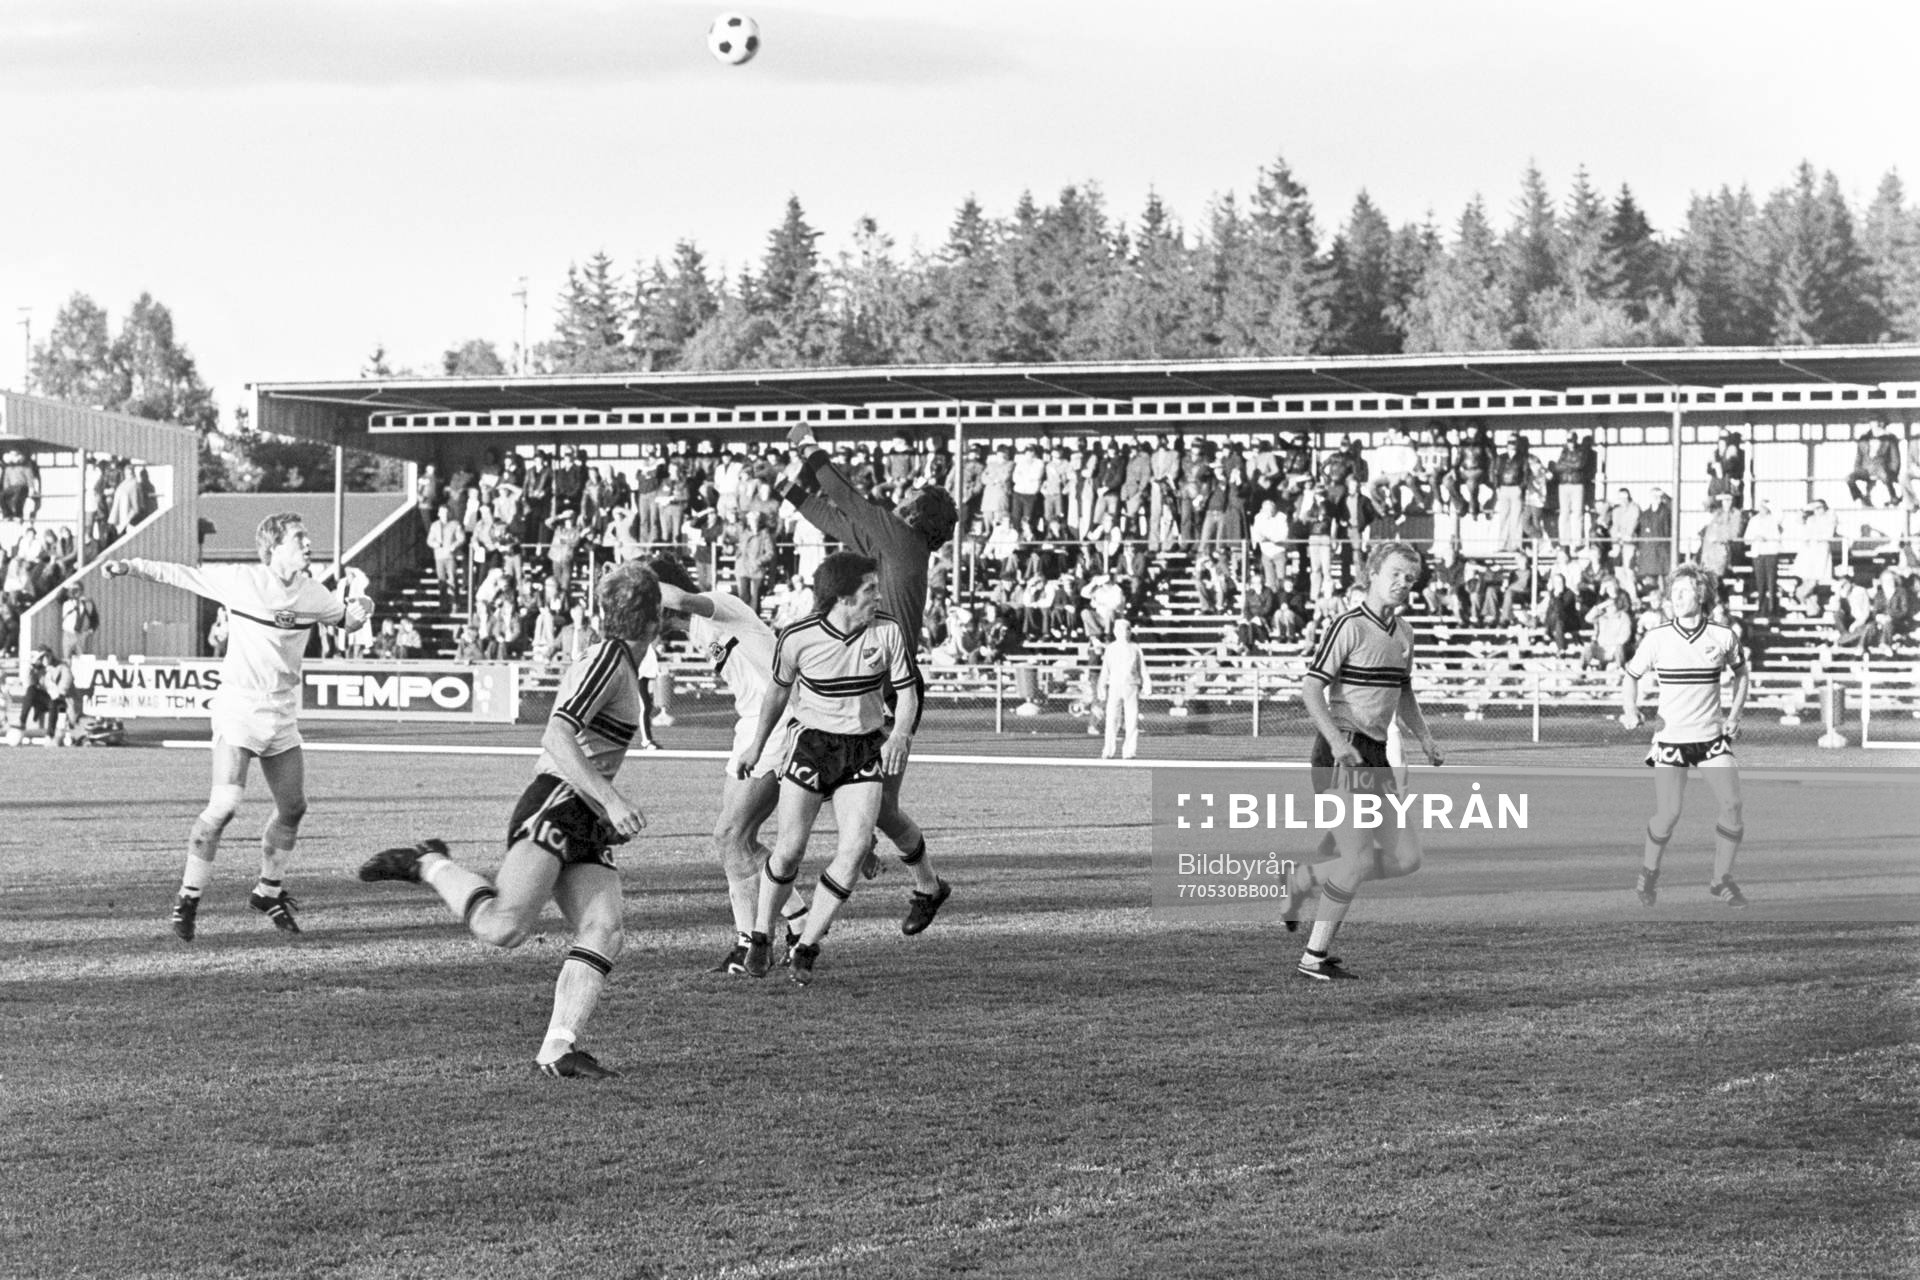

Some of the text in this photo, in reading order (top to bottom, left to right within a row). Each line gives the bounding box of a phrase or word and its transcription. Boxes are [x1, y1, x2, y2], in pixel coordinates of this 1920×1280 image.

[306, 675, 469, 708] TEMPO
[1658, 747, 1684, 764] ICA
[789, 761, 819, 790] ICA
